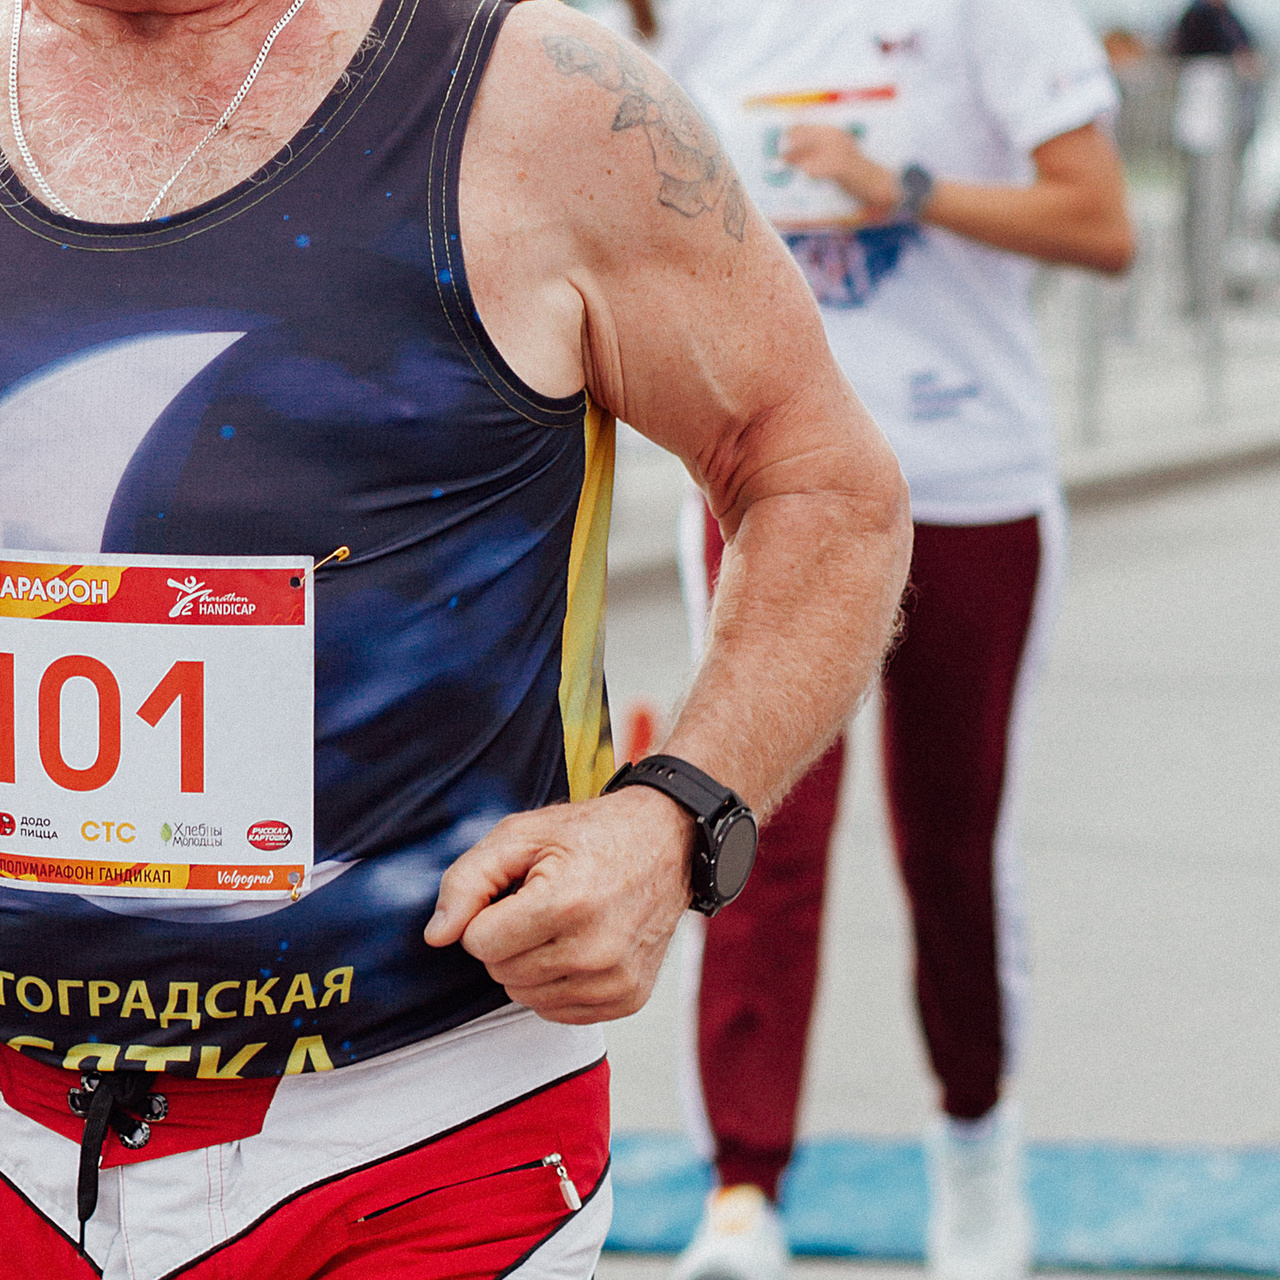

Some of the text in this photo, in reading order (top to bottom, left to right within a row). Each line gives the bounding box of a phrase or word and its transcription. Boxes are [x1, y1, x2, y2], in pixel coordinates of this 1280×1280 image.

[199, 603, 256, 616] HANDICAP
[20, 816, 51, 827] ДОДО
[20, 828, 59, 840] ПИЦЦА
[0, 857, 172, 885] ПОЛУМАРАФОН ГАНДИКАП
[217, 869, 274, 889] Volgograd
